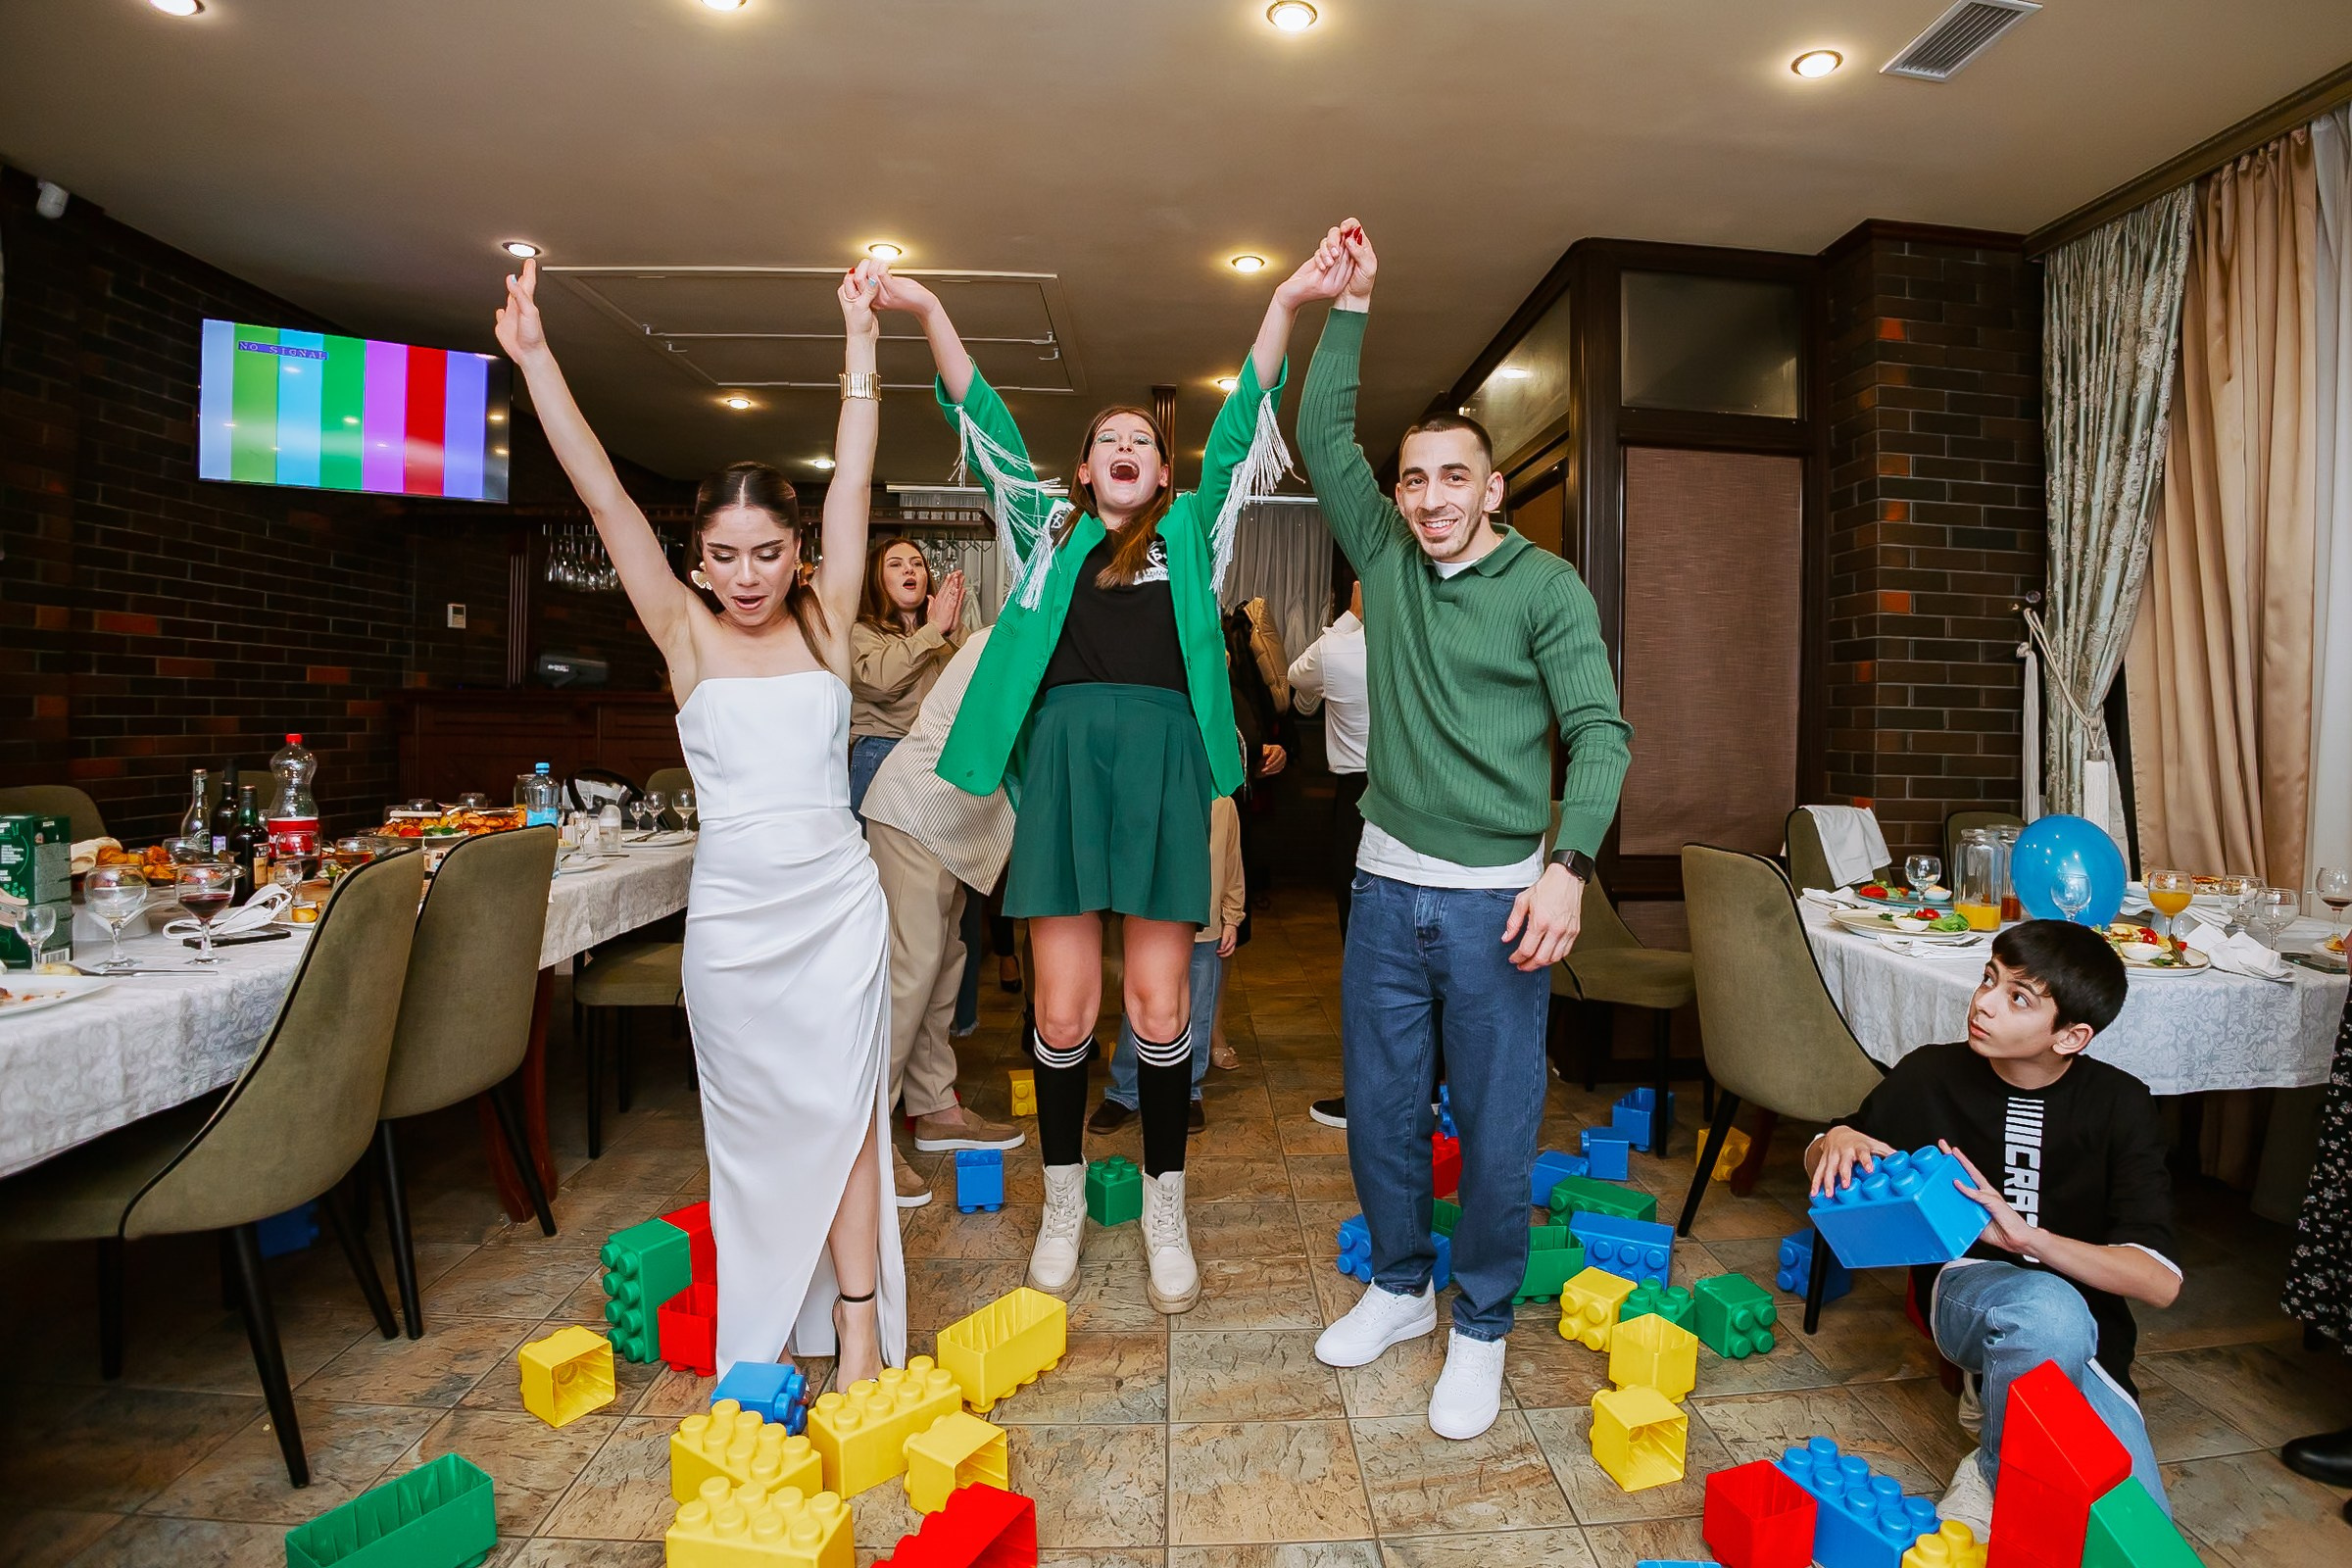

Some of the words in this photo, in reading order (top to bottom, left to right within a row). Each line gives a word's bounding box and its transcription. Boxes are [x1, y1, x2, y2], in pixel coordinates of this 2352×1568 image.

[239, 341, 259, 352] NO
[269, 345, 325, 360] SIGNAL
[2003, 1143, 2041, 1264] CRA
